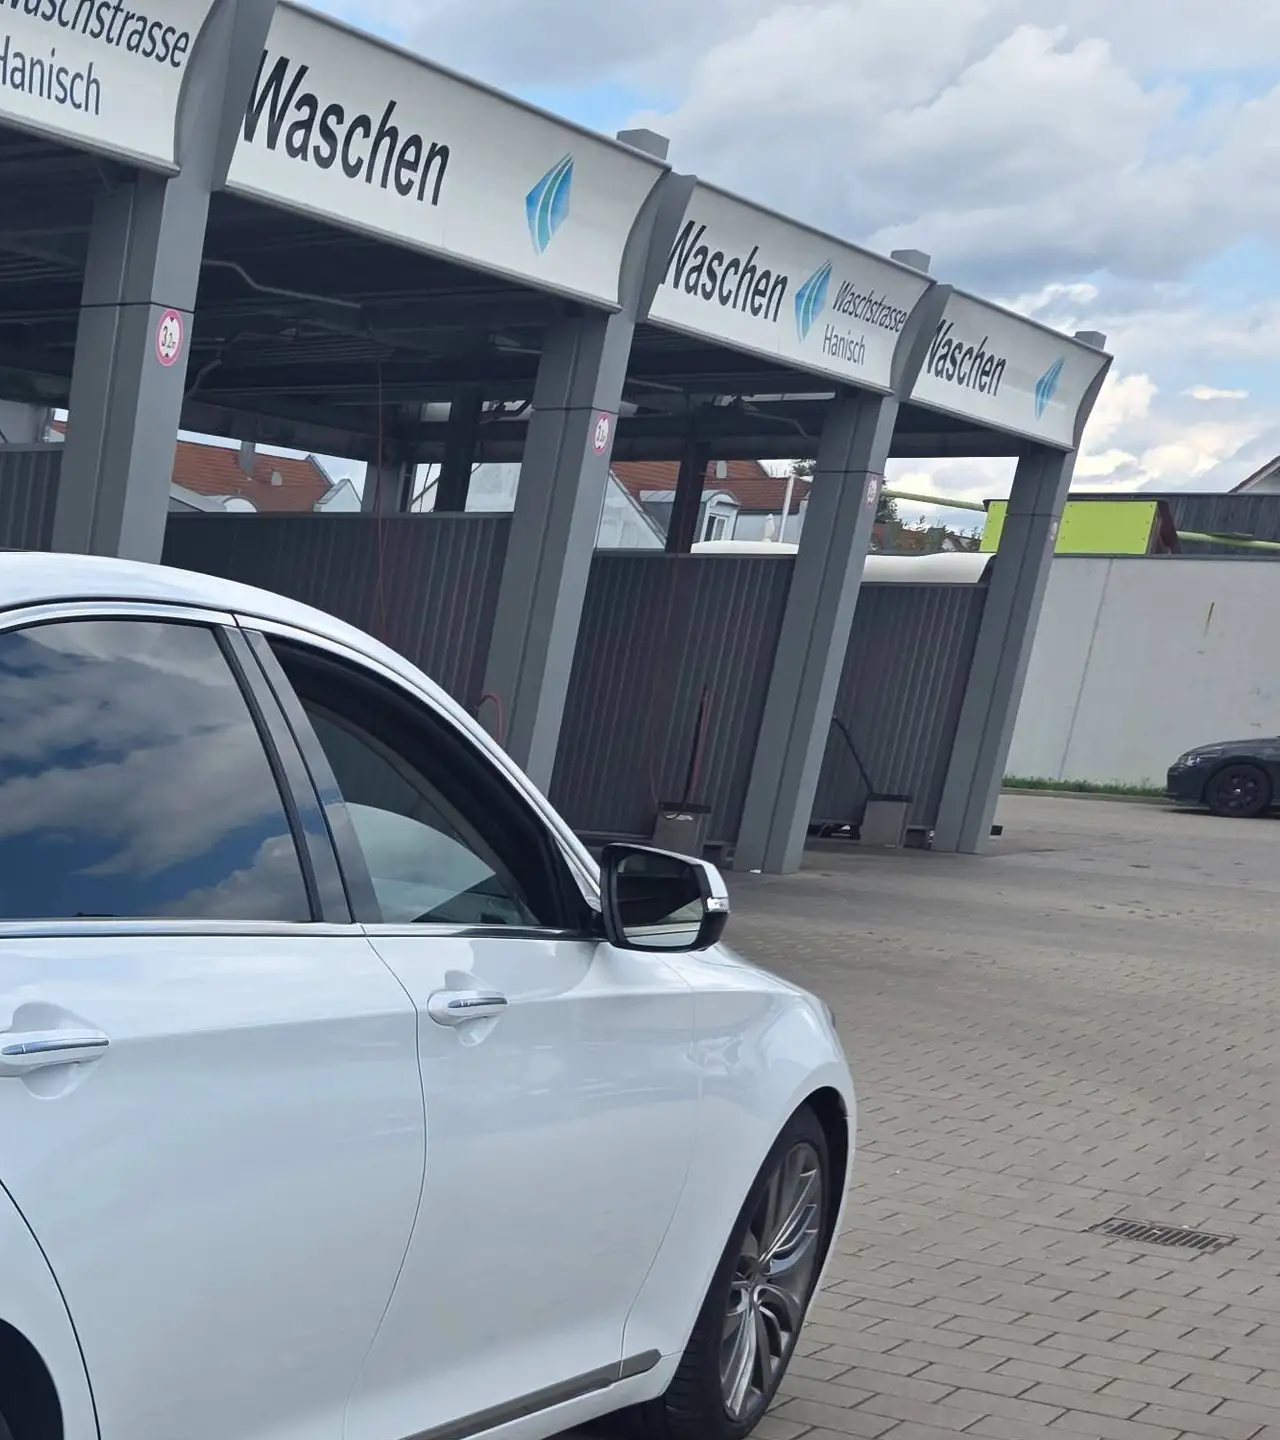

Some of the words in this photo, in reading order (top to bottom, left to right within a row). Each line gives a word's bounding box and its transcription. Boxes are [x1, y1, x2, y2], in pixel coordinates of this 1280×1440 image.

[243, 49, 450, 206] Waschen
[832, 280, 907, 332] Waschstrasse
[822, 324, 865, 365] Hanisch
